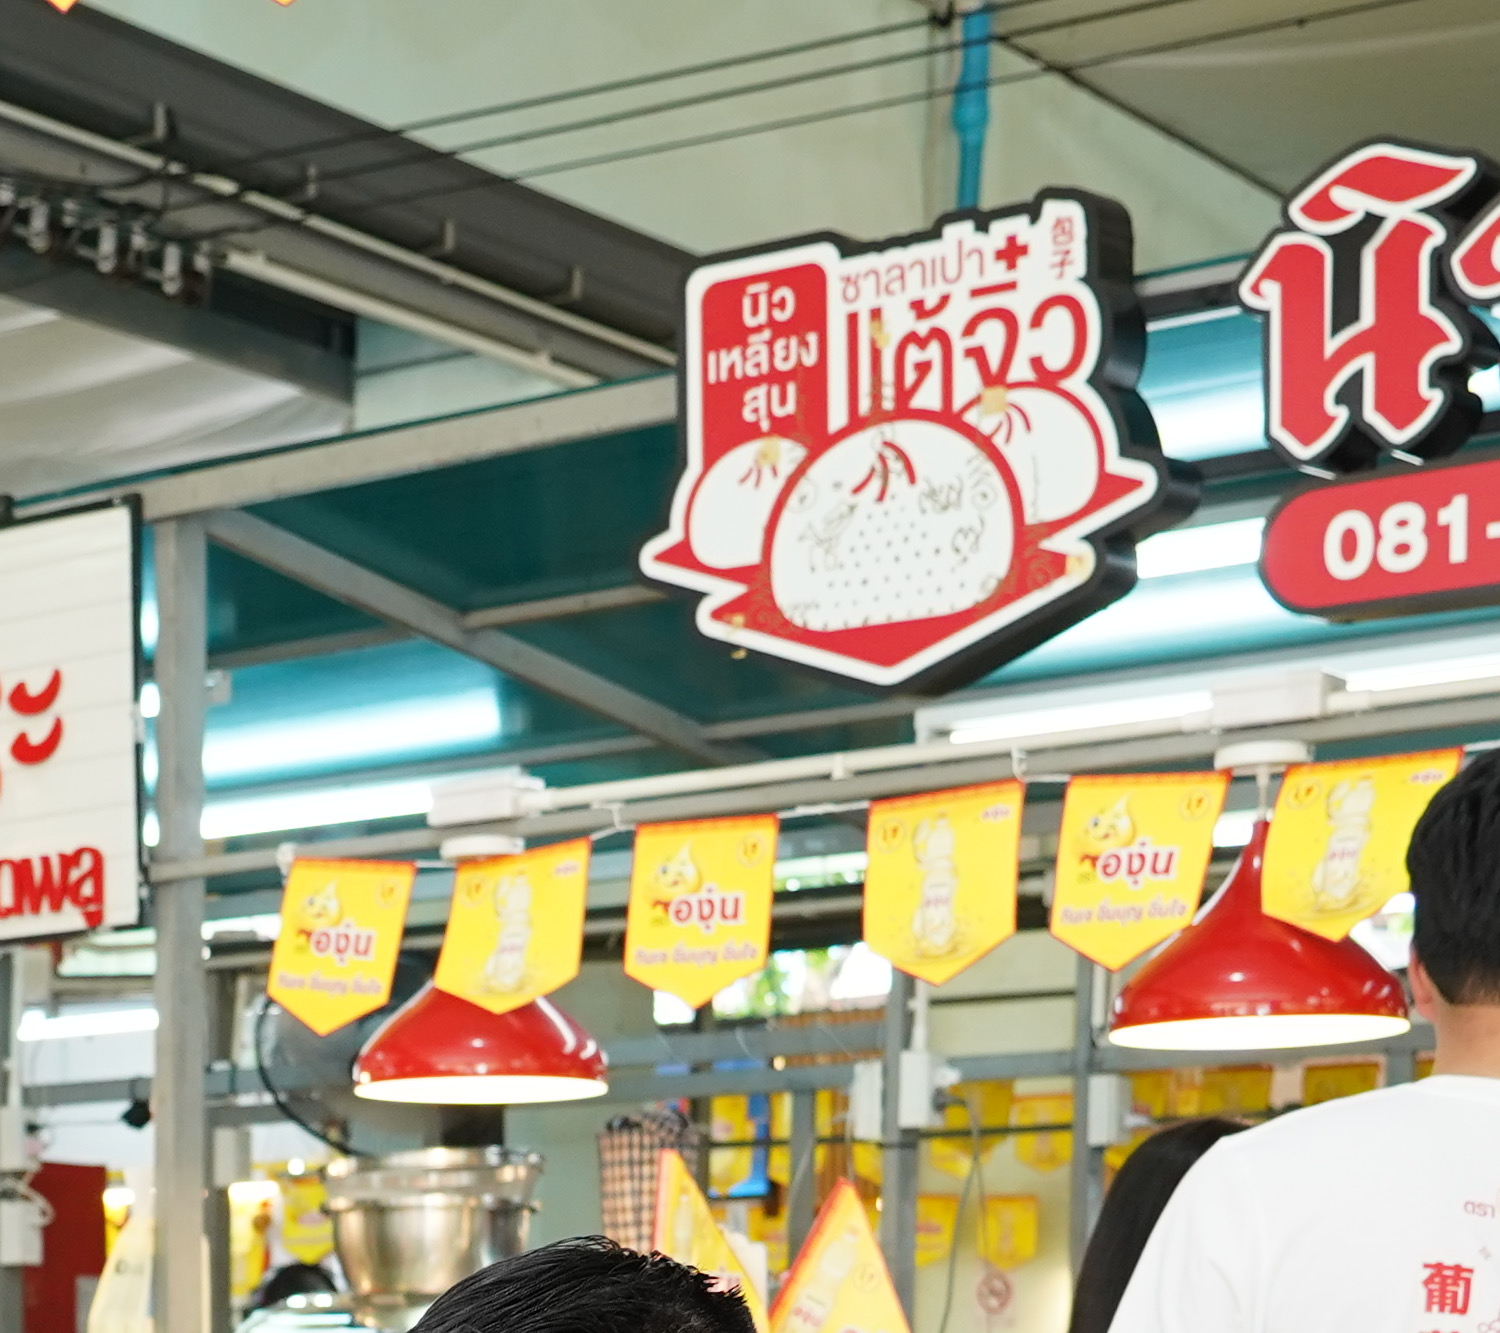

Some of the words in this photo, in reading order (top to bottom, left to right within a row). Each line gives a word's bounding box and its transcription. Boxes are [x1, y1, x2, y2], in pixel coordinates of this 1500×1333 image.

[839, 238, 984, 304] ซาลาเปา
[1050, 216, 1074, 279] 包子
[741, 281, 797, 328] นิว
[707, 330, 819, 384] เหลียง
[741, 380, 798, 432] สุน
[1101, 841, 1176, 887] องุ่น
[672, 887, 742, 931] องุ่น
